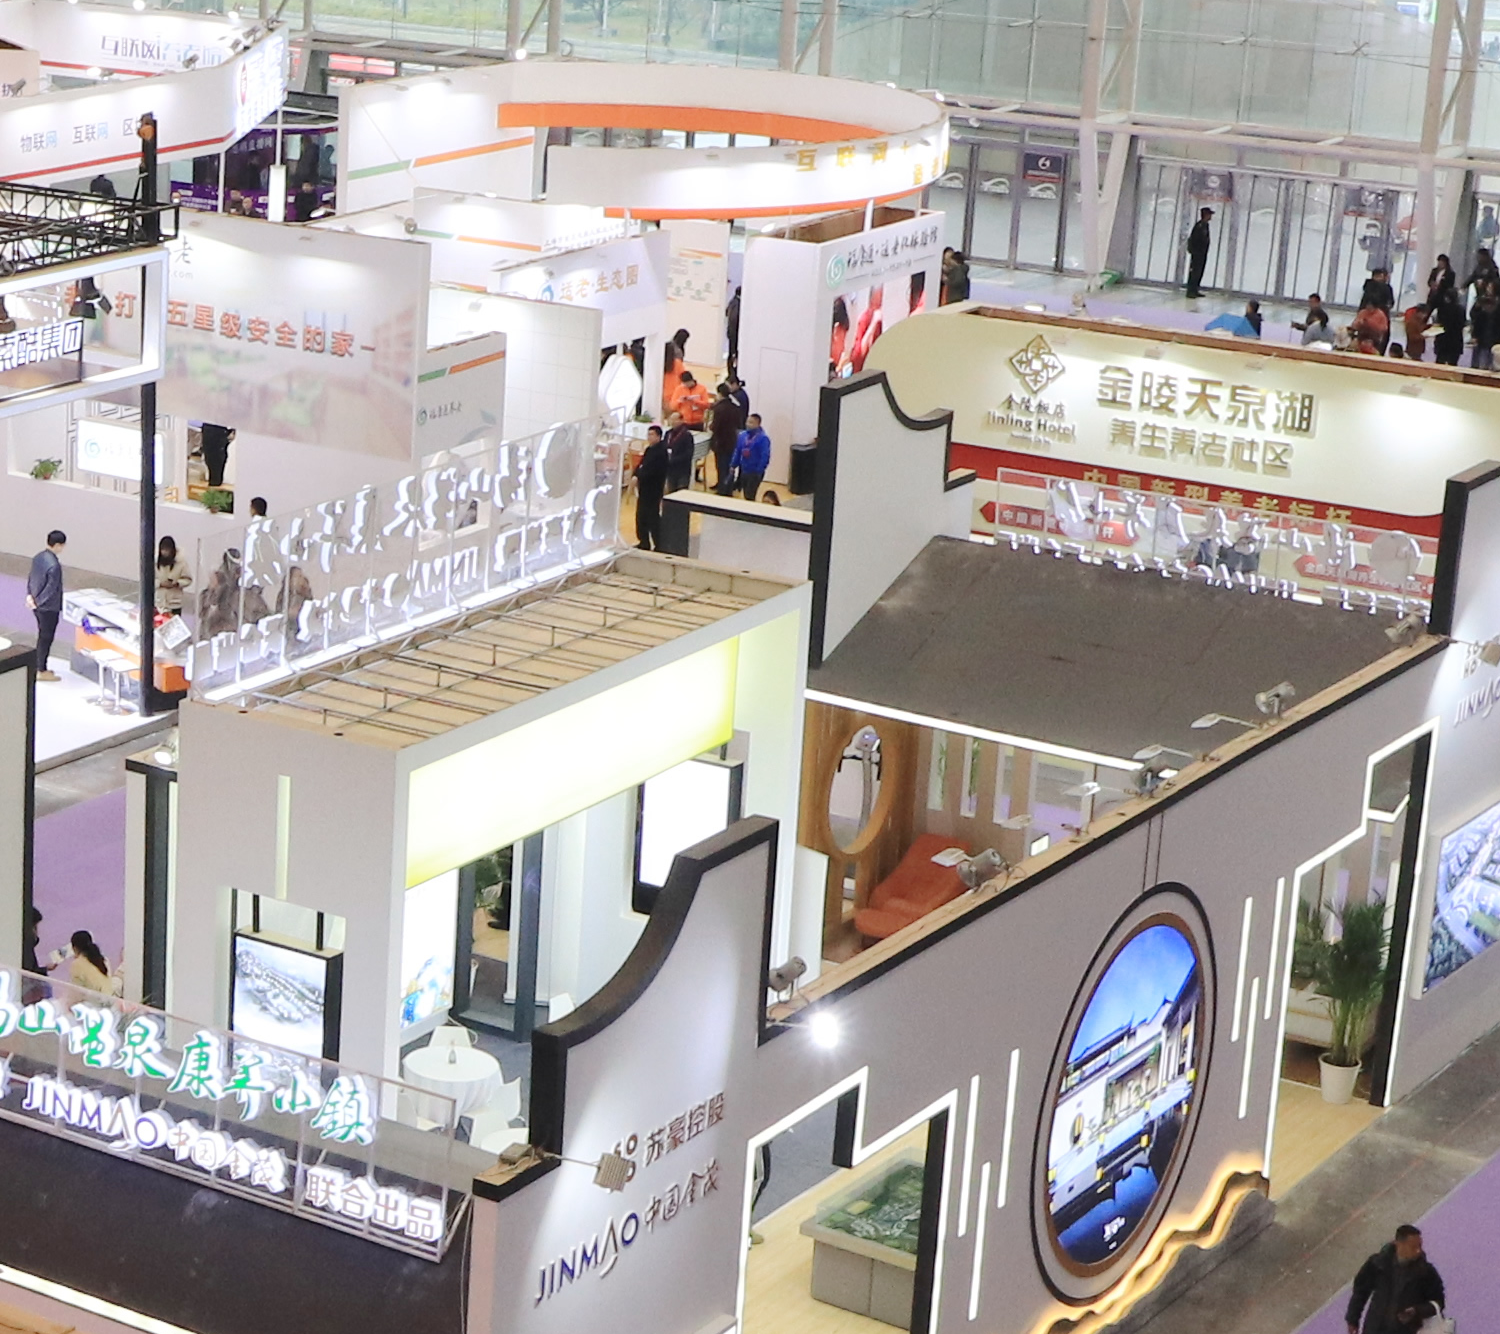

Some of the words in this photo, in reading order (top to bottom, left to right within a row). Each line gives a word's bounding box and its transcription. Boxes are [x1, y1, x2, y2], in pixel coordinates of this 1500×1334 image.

[72, 122, 109, 145] 互联网
[1001, 393, 1067, 420] 金陵饭店
[1036, 416, 1078, 438] Hotel
[1096, 364, 1316, 436] 金陵天泉湖
[1109, 416, 1295, 474] 养生养老社区
[22, 1075, 163, 1152] JINMAO
[305, 1168, 443, 1237] 联合出品
[643, 1091, 726, 1169] 苏豪控股
[534, 1211, 640, 1308] JINMAO
